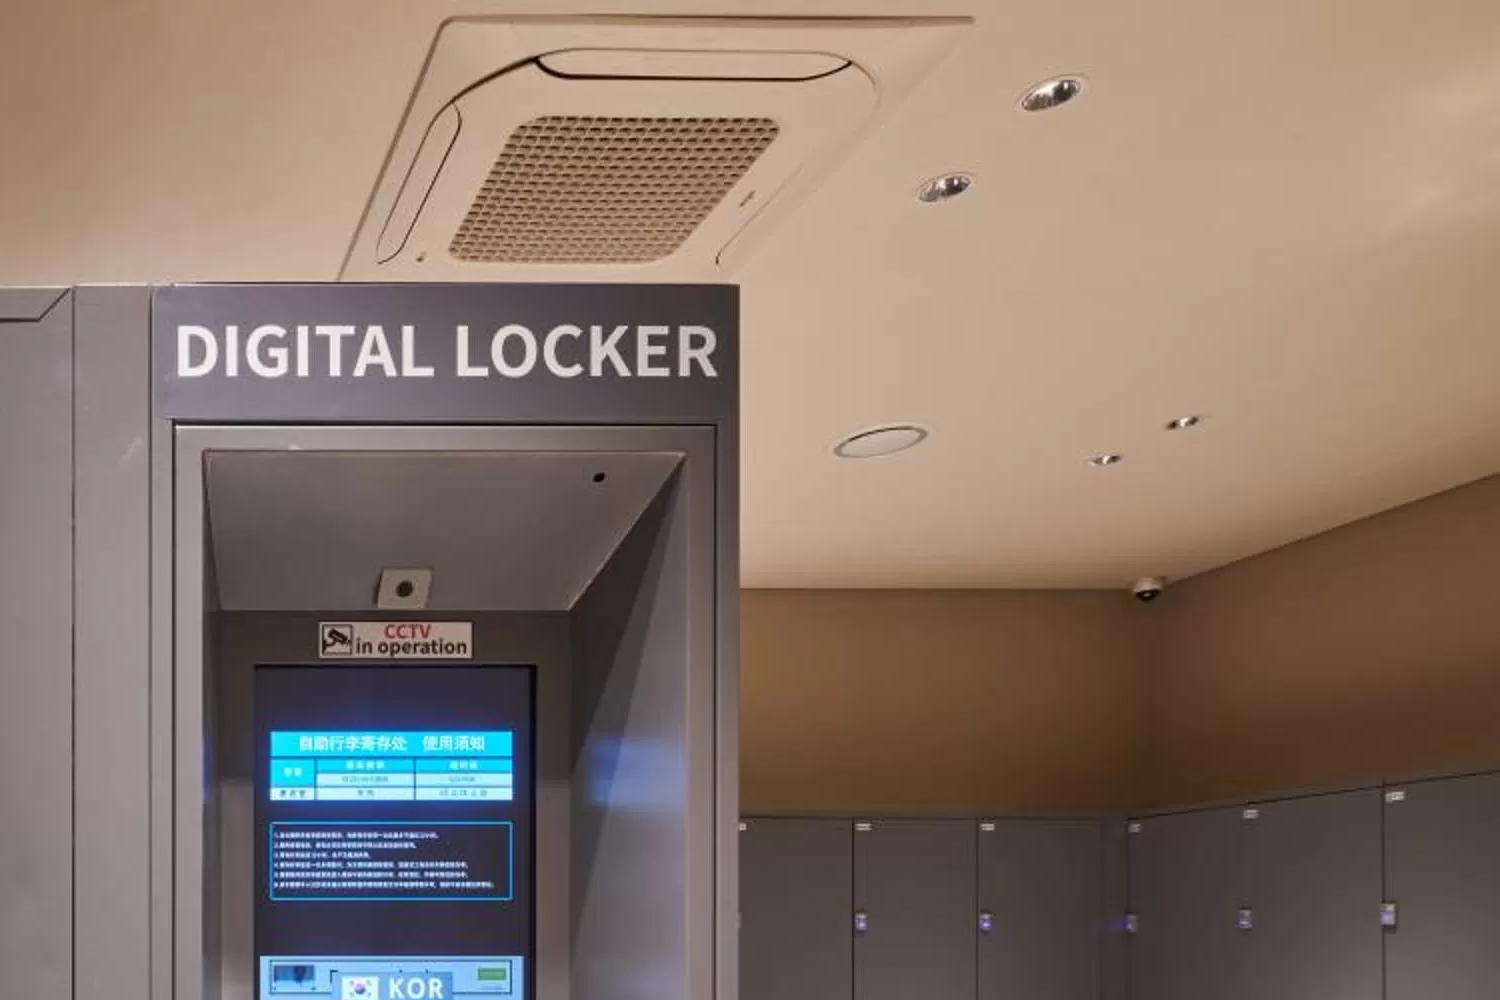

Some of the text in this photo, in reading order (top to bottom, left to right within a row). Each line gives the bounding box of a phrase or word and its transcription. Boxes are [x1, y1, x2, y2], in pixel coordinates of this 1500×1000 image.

[177, 325, 717, 377] DIGITAL LOCKER
[384, 624, 431, 638] CCTV
[356, 638, 467, 656] in operation
[389, 977, 443, 1000] KOR
